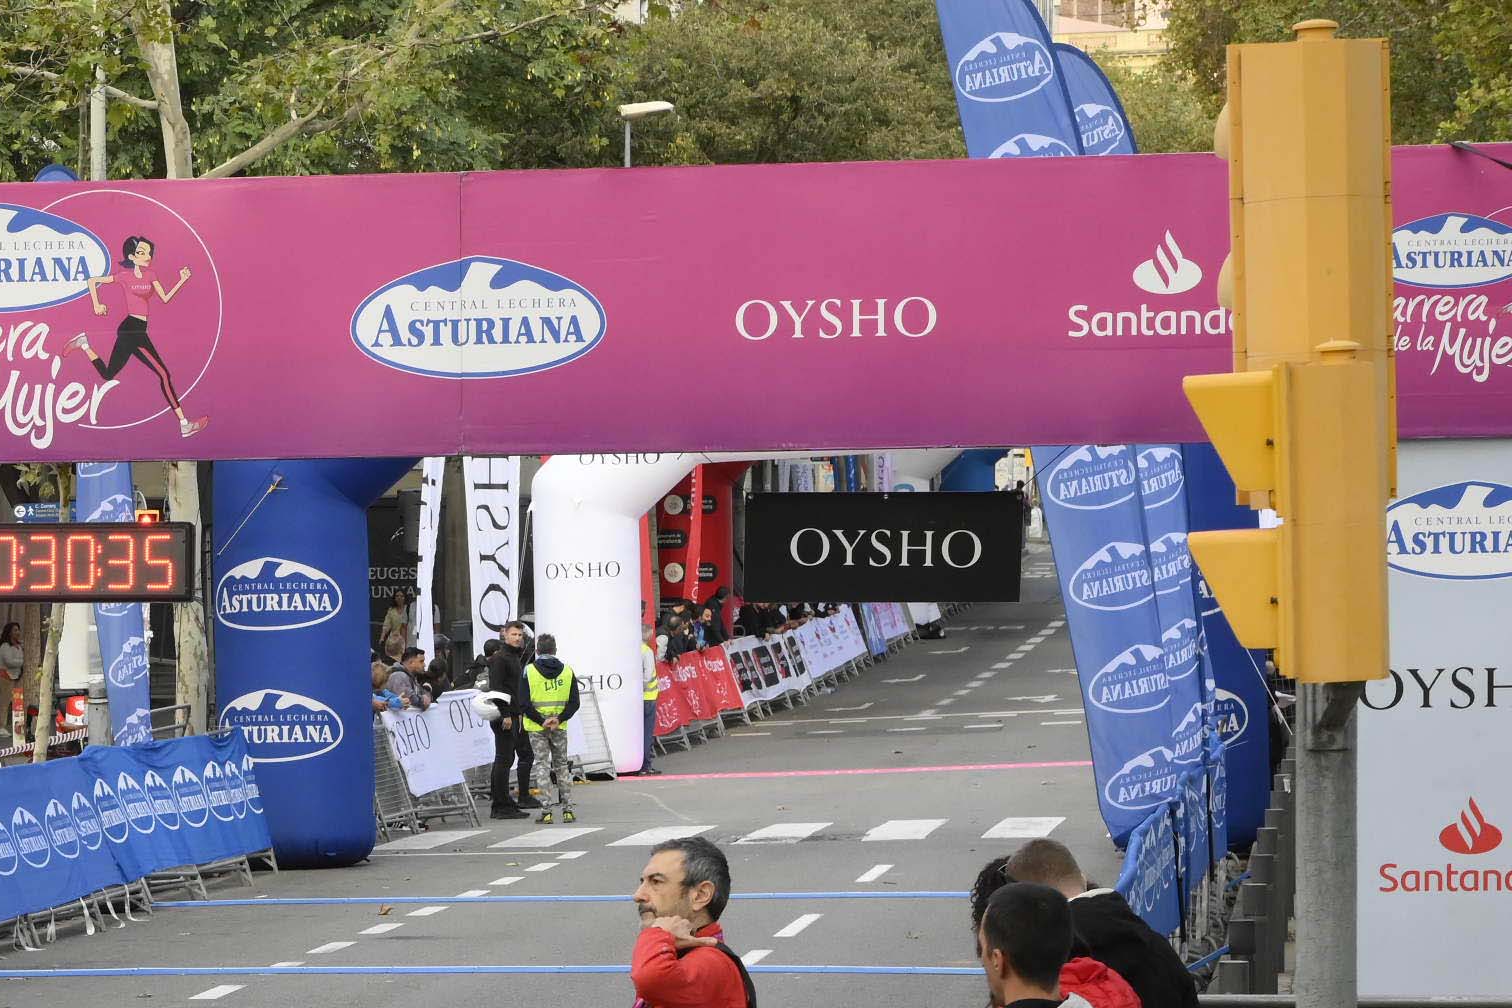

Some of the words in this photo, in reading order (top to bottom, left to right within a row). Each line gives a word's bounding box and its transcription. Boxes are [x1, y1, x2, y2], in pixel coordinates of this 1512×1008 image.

[13, 240, 85, 251] LECHERA
[1407, 239, 1459, 247] CENTRAL
[410, 299, 489, 312] CENTRAL
[497, 297, 577, 309] LECHERA
[1392, 294, 1488, 323] arrera
[371, 303, 586, 348] ASTURIANA
[735, 296, 938, 341] OYSHO
[1417, 324, 1434, 351] la
[579, 453, 660, 465] OYSHO
[1414, 516, 1481, 526] CENTRAL
[790, 528, 982, 568] OYSHO
[546, 561, 621, 580] OYSHO
[233, 582, 275, 591] CENTRAL
[279, 582, 328, 590] LECHERA
[220, 587, 333, 615] ASTURIANA
[544, 679, 564, 692] Life
